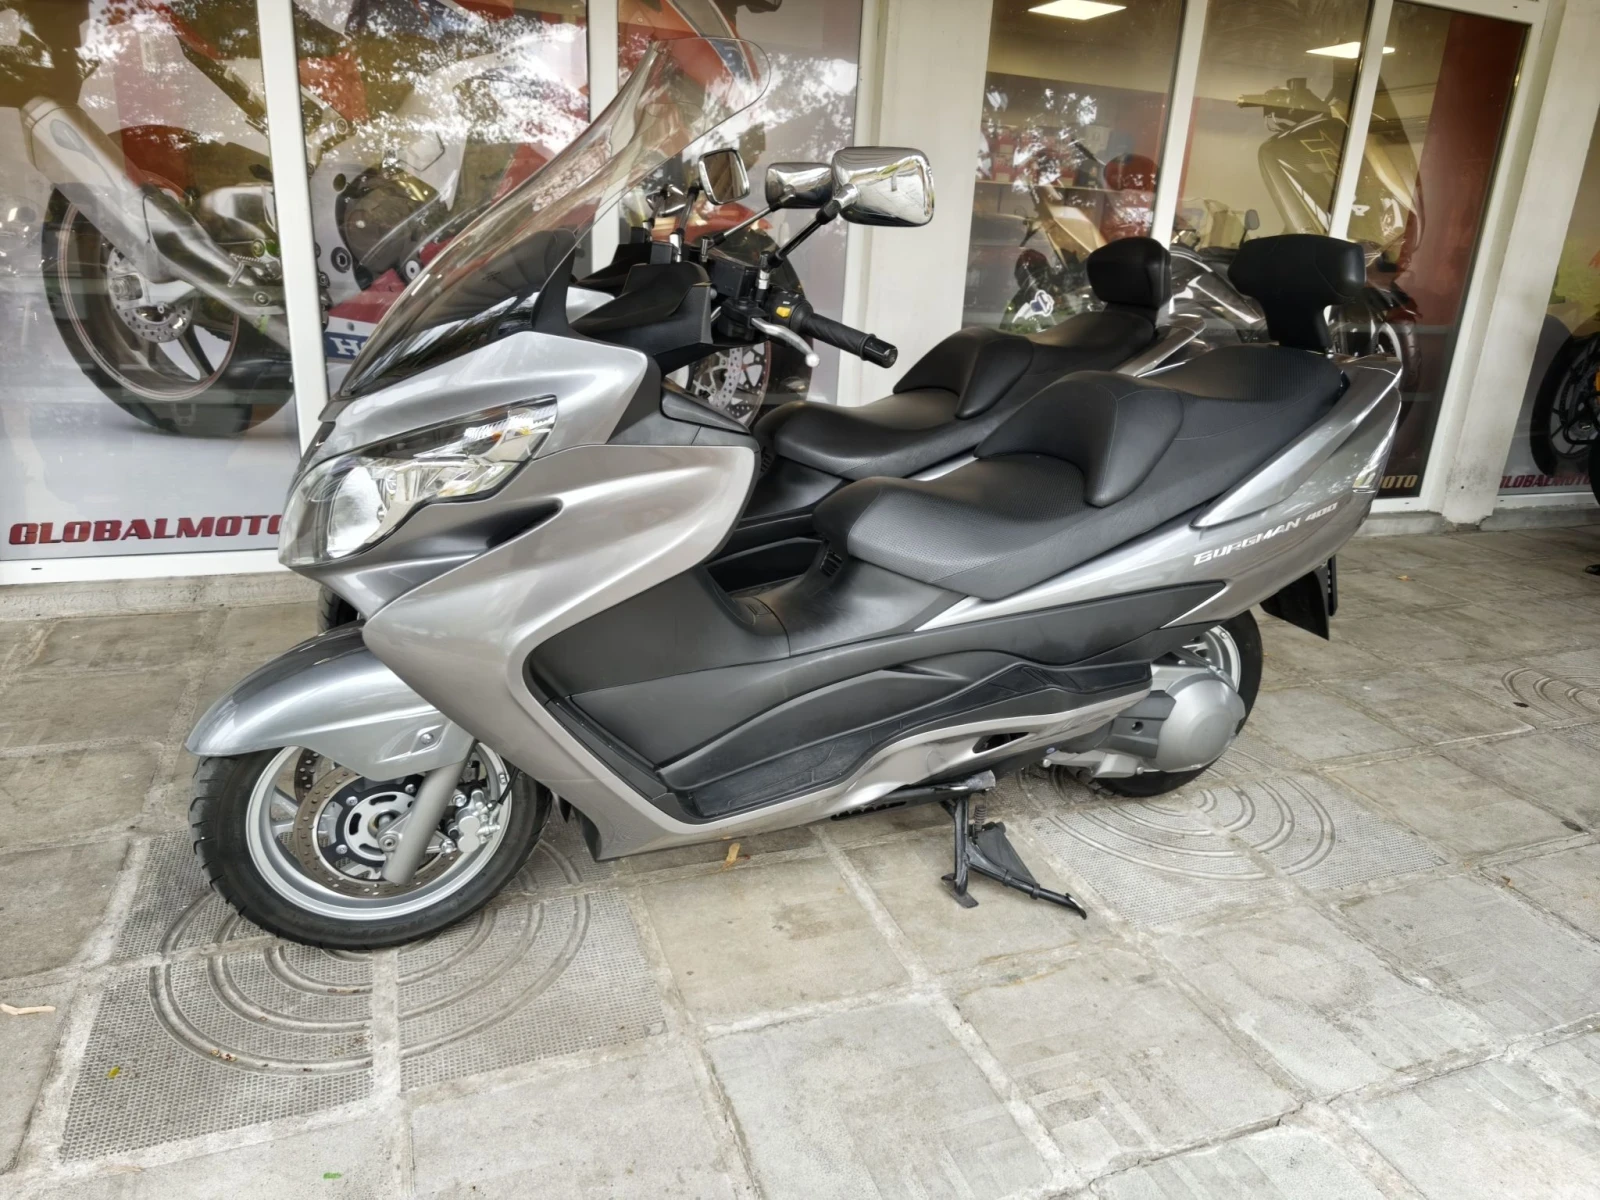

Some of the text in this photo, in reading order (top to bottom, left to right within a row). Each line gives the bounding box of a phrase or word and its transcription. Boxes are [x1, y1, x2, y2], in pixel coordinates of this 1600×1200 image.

[1379, 474, 1418, 489] OTO
[1193, 502, 1338, 566] BURGMAN 400
